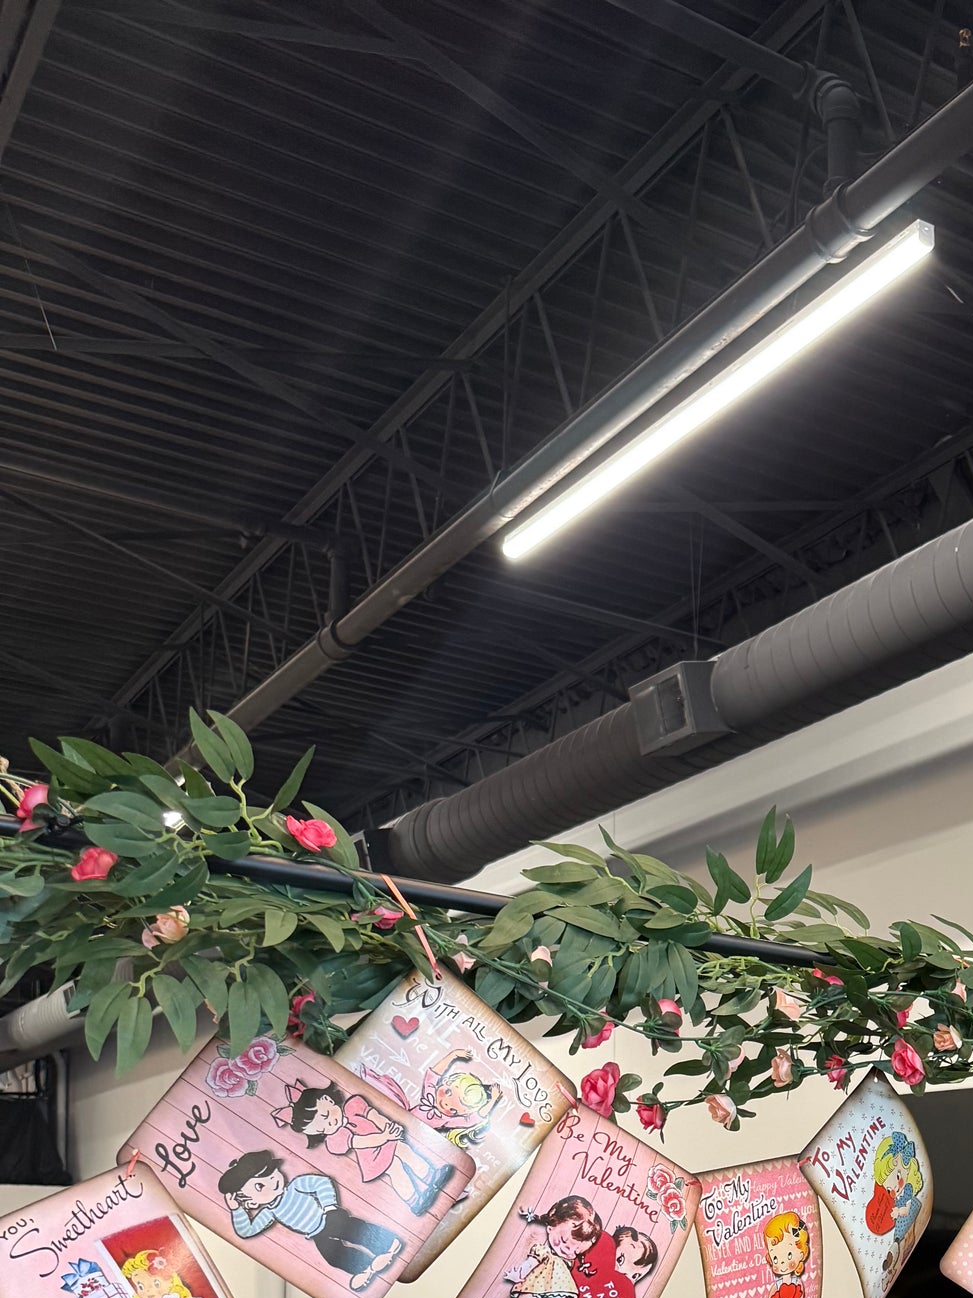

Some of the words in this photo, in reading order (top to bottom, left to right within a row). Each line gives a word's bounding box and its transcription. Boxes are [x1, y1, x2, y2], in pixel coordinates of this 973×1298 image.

[462, 1016, 486, 1042] ALL
[486, 1037, 521, 1067] MY
[512, 1061, 553, 1123] LOVE
[155, 1100, 211, 1188] Love
[556, 1112, 585, 1142] Be
[592, 1131, 637, 1177] My
[811, 1146, 830, 1178] TO
[836, 1131, 856, 1166] MY
[831, 1116, 886, 1200] VALENTINE
[572, 1151, 659, 1223] Valentine
[700, 1187, 724, 1220] To
[723, 1175, 750, 1203] My
[706, 1194, 777, 1247] Valentine
